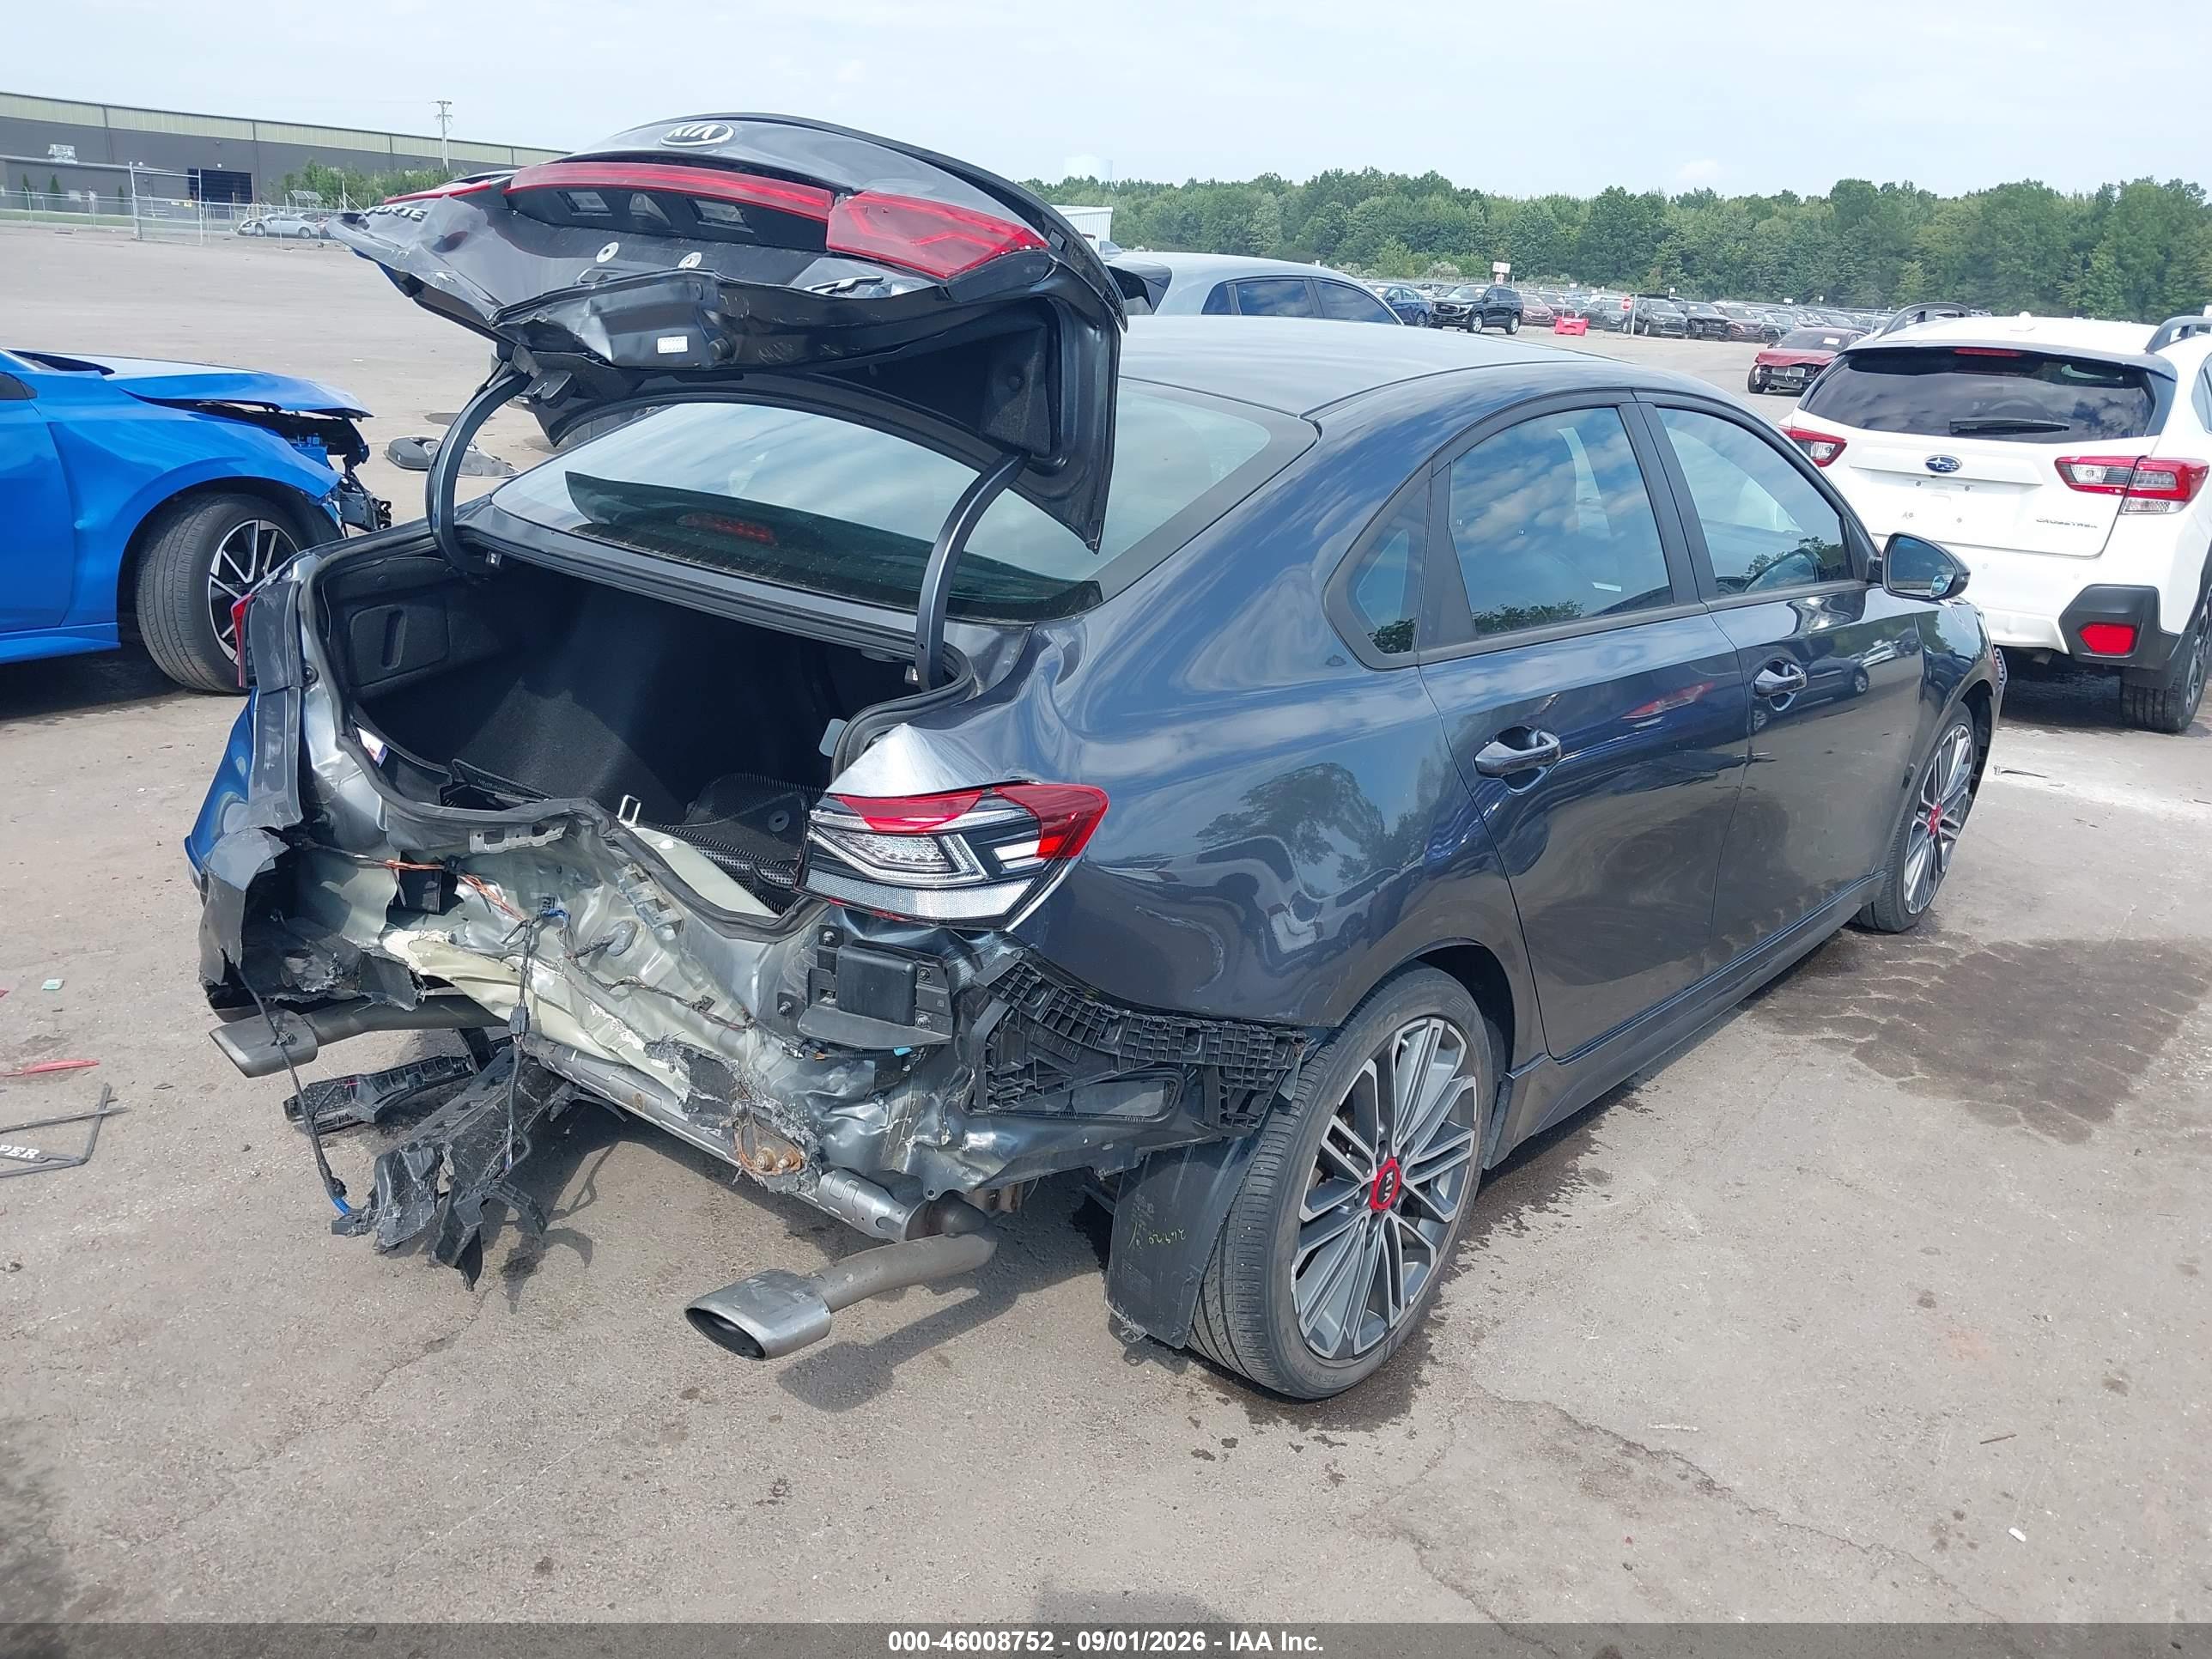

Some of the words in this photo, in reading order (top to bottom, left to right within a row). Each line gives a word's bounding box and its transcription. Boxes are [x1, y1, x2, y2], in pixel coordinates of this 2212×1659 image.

[665, 123, 718, 139] KIA
[364, 206, 428, 222] FORTE
[1382, 1170, 1394, 1203] KIA
